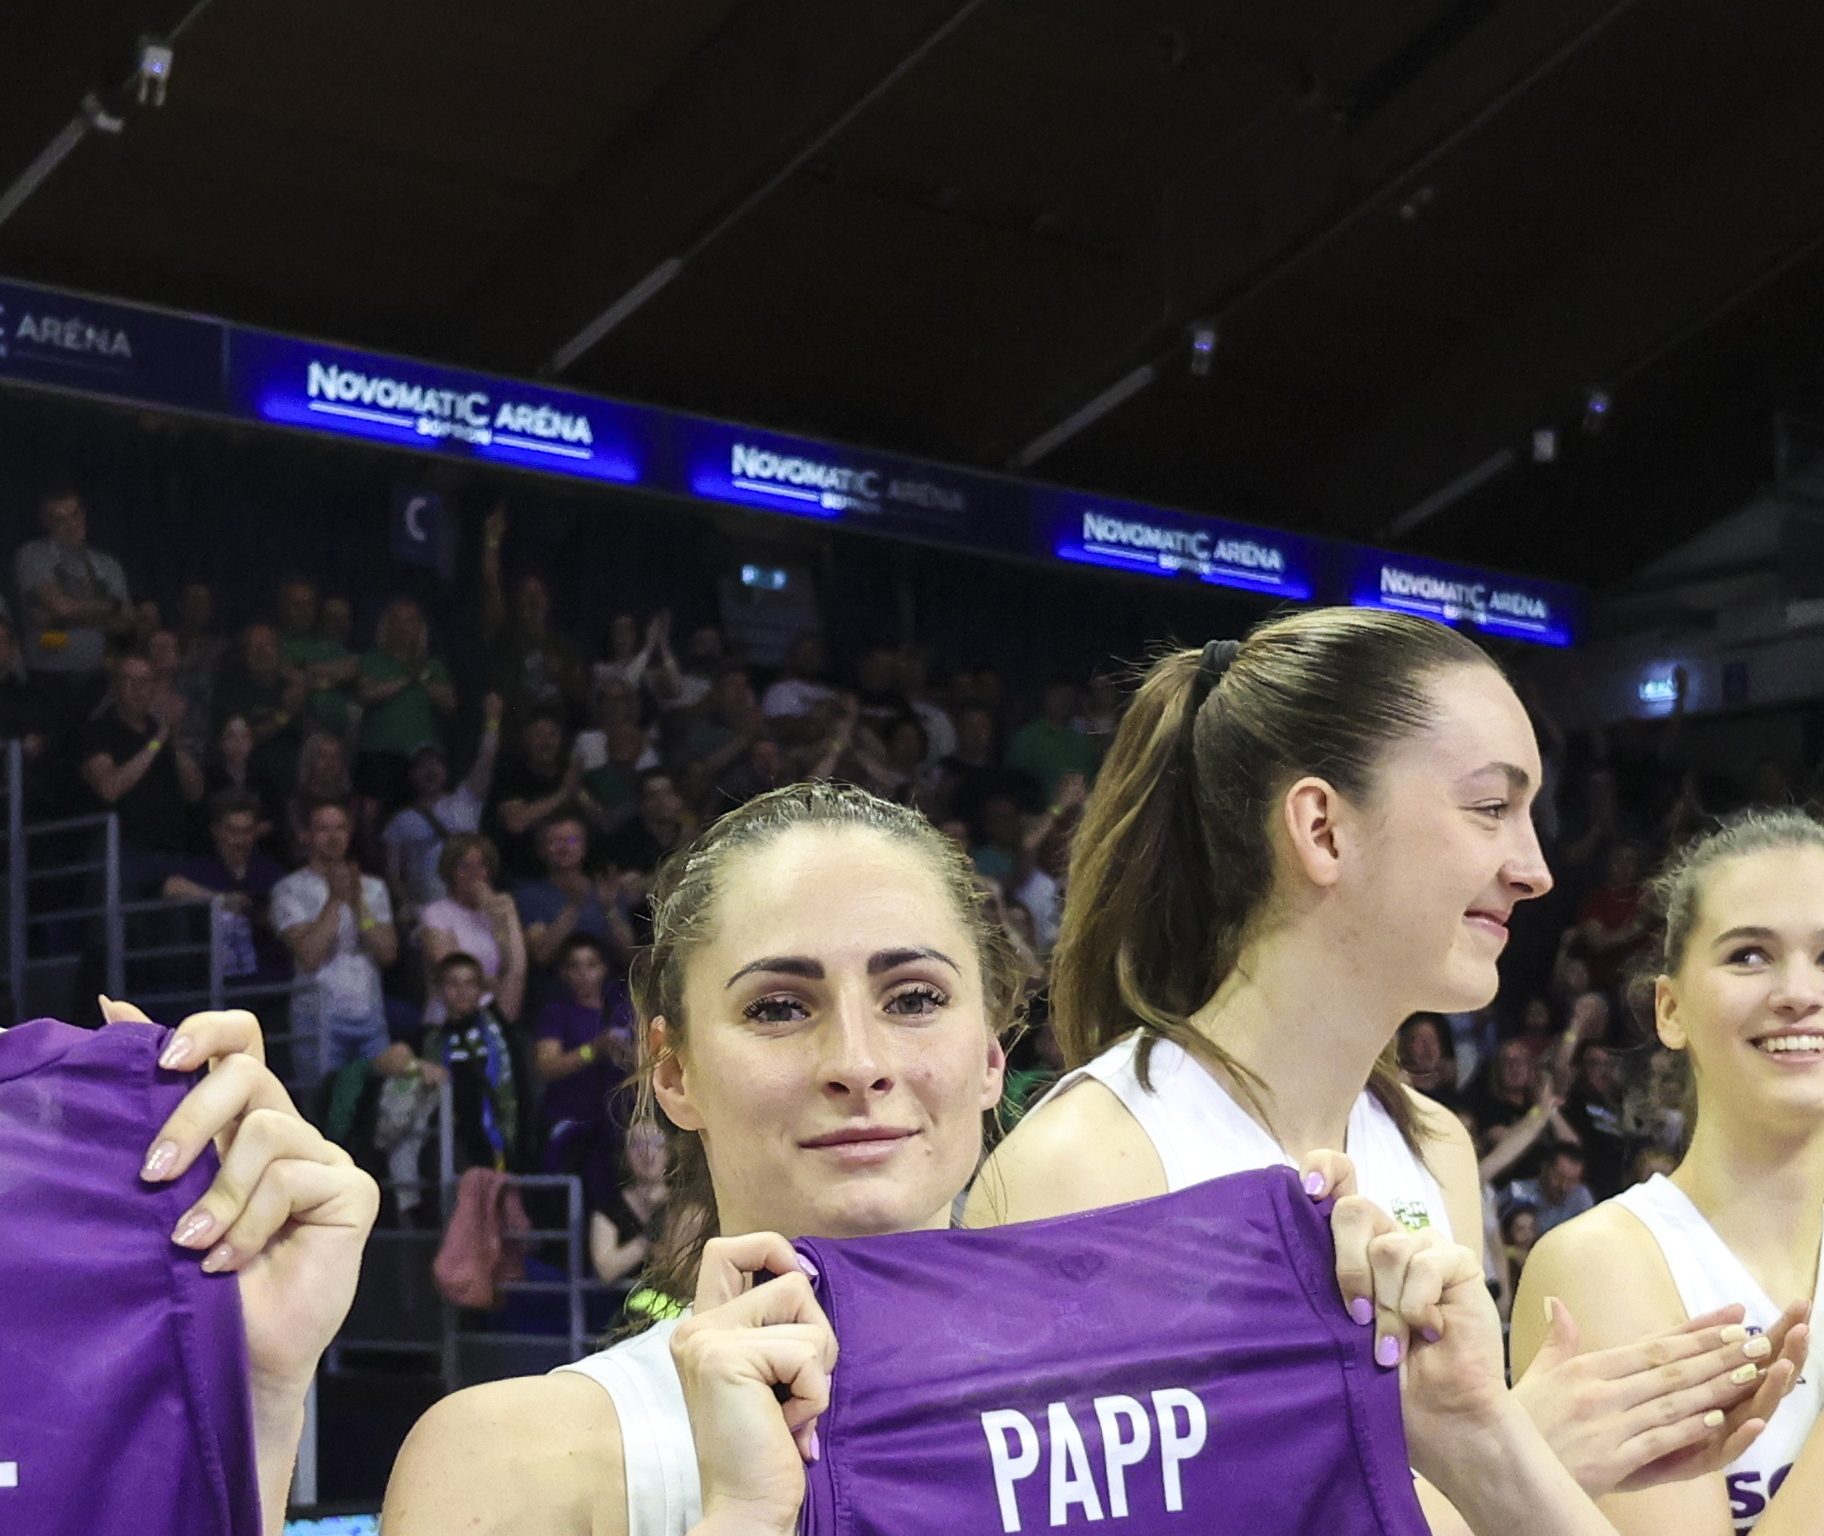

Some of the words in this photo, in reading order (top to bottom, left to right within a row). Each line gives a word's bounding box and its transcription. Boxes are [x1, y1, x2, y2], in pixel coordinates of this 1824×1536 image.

[308, 360, 490, 428] NOVOMATIC
[494, 402, 594, 445] ARÉNA
[980, 1387, 1207, 1533] PAPP
